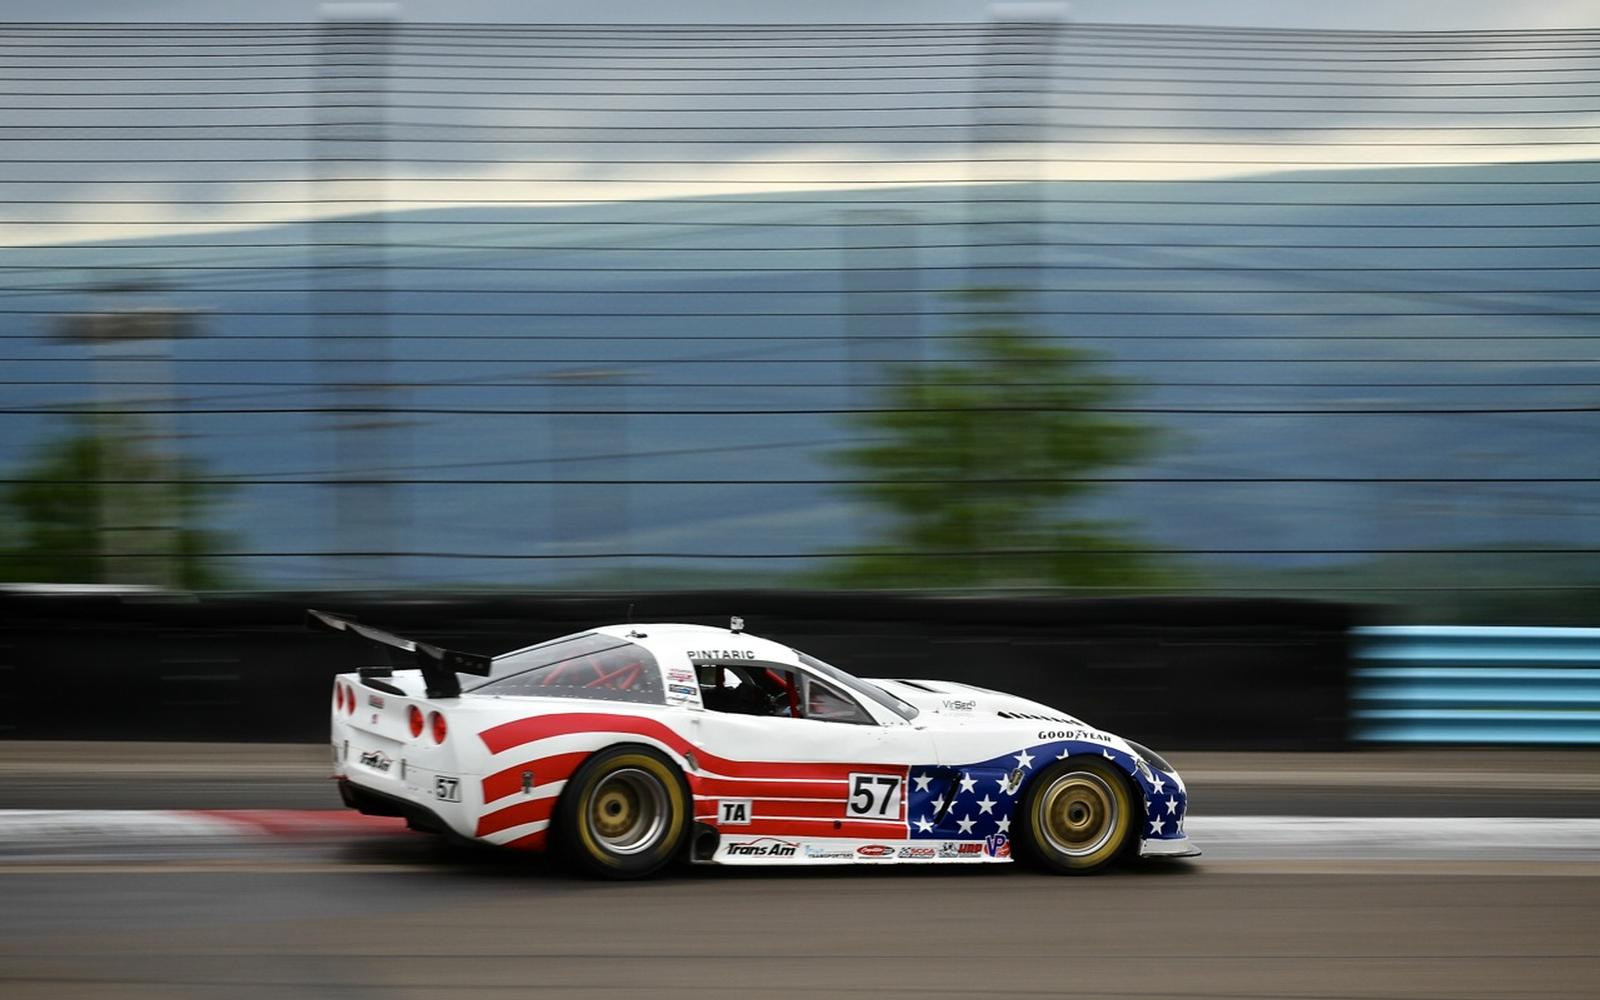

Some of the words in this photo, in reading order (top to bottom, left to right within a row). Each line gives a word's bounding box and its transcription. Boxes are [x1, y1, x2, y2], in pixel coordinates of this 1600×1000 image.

[686, 650, 755, 660] PINTARIC
[1038, 730, 1112, 743] GOODYEAR
[435, 778, 459, 800] 57
[850, 776, 900, 815] 57
[723, 803, 746, 821] TA
[727, 842, 769, 855] Trans
[767, 843, 796, 856] Am
